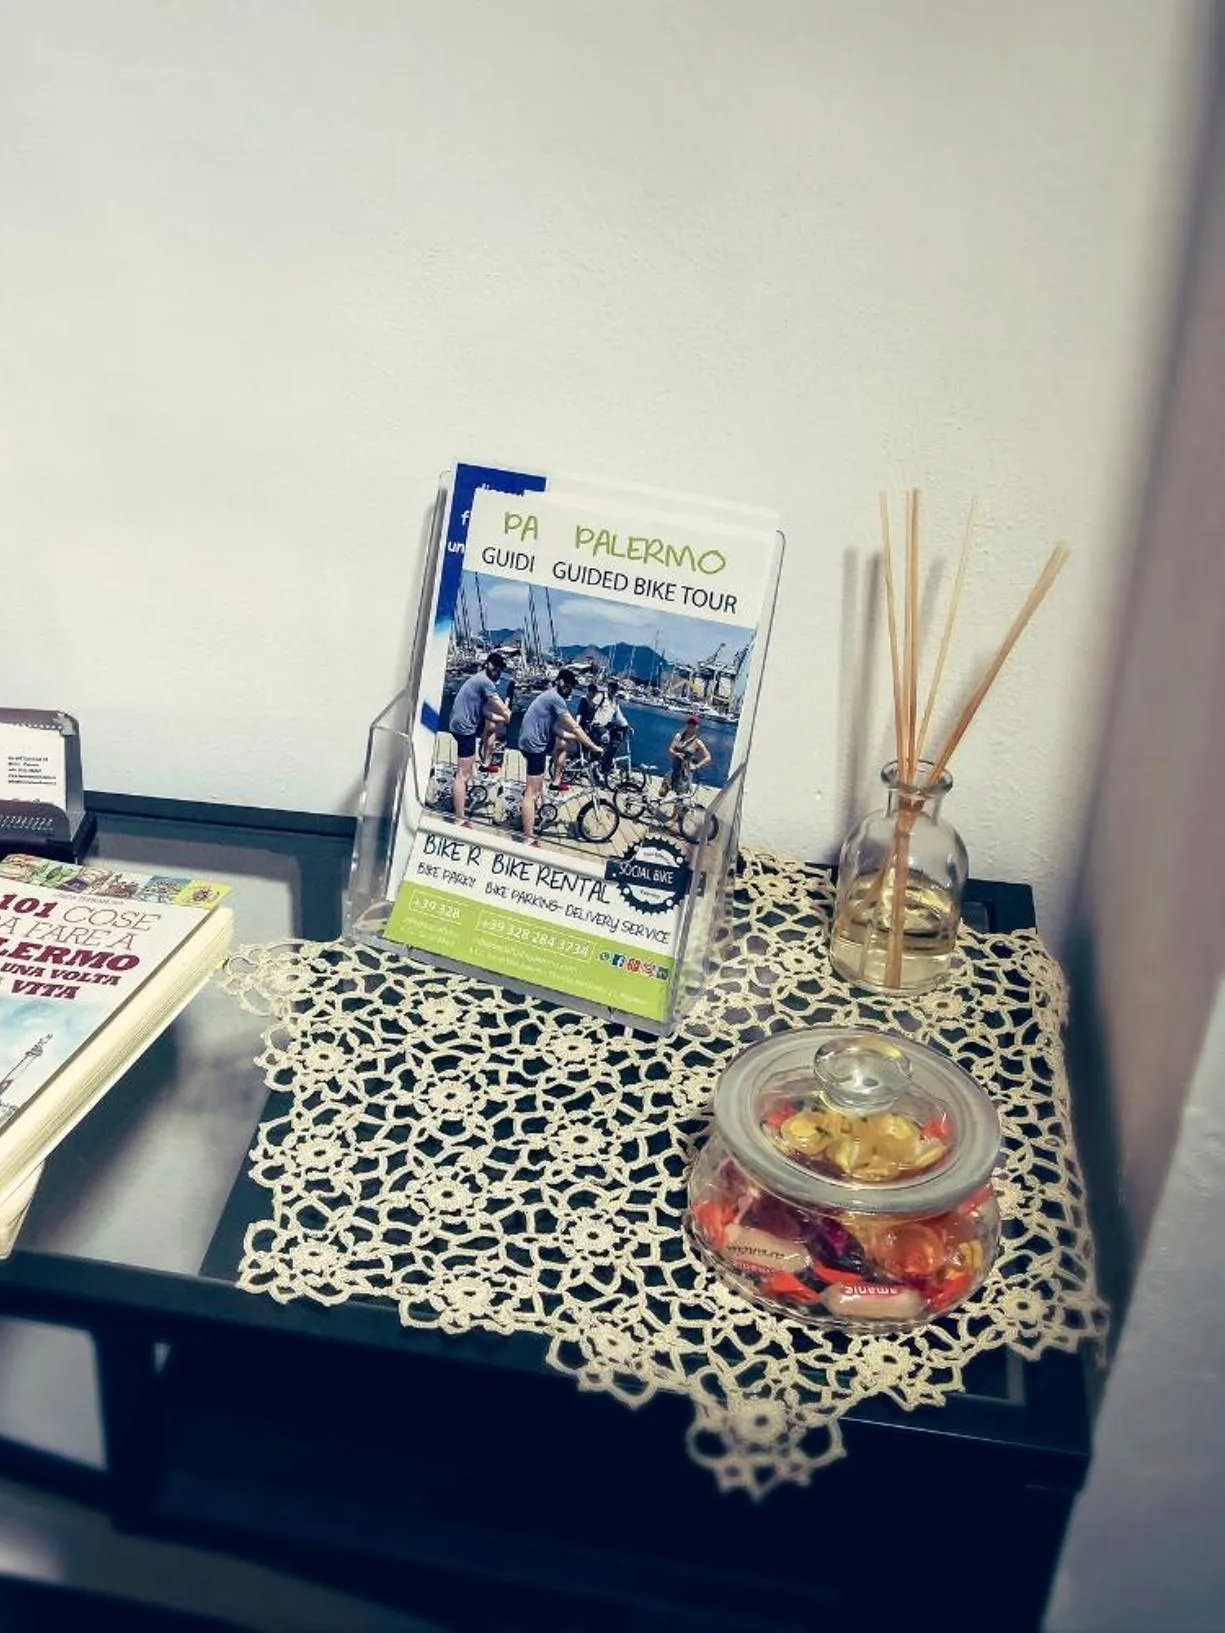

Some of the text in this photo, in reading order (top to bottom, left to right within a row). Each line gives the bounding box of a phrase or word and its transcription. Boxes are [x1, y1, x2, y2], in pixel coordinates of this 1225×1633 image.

[504, 512, 538, 541] PA
[576, 525, 726, 574] PALERMO
[552, 561, 737, 614] GUIDED BIKE TOUR
[423, 834, 464, 861] BIKE
[417, 862, 441, 878] BIKE
[491, 853, 610, 904] BIKE RENTAL
[619, 862, 651, 881] SOCIAL
[62, 906, 162, 932] COSE
[485, 882, 509, 898] BIKE
[565, 904, 620, 933] DELIVERY
[622, 920, 671, 945] SERVICE
[28, 923, 104, 948] FARE
[105, 933, 136, 951] A
[0, 961, 45, 978] UNA
[49, 968, 122, 986] VOLTA
[10, 978, 81, 1000] VITA
